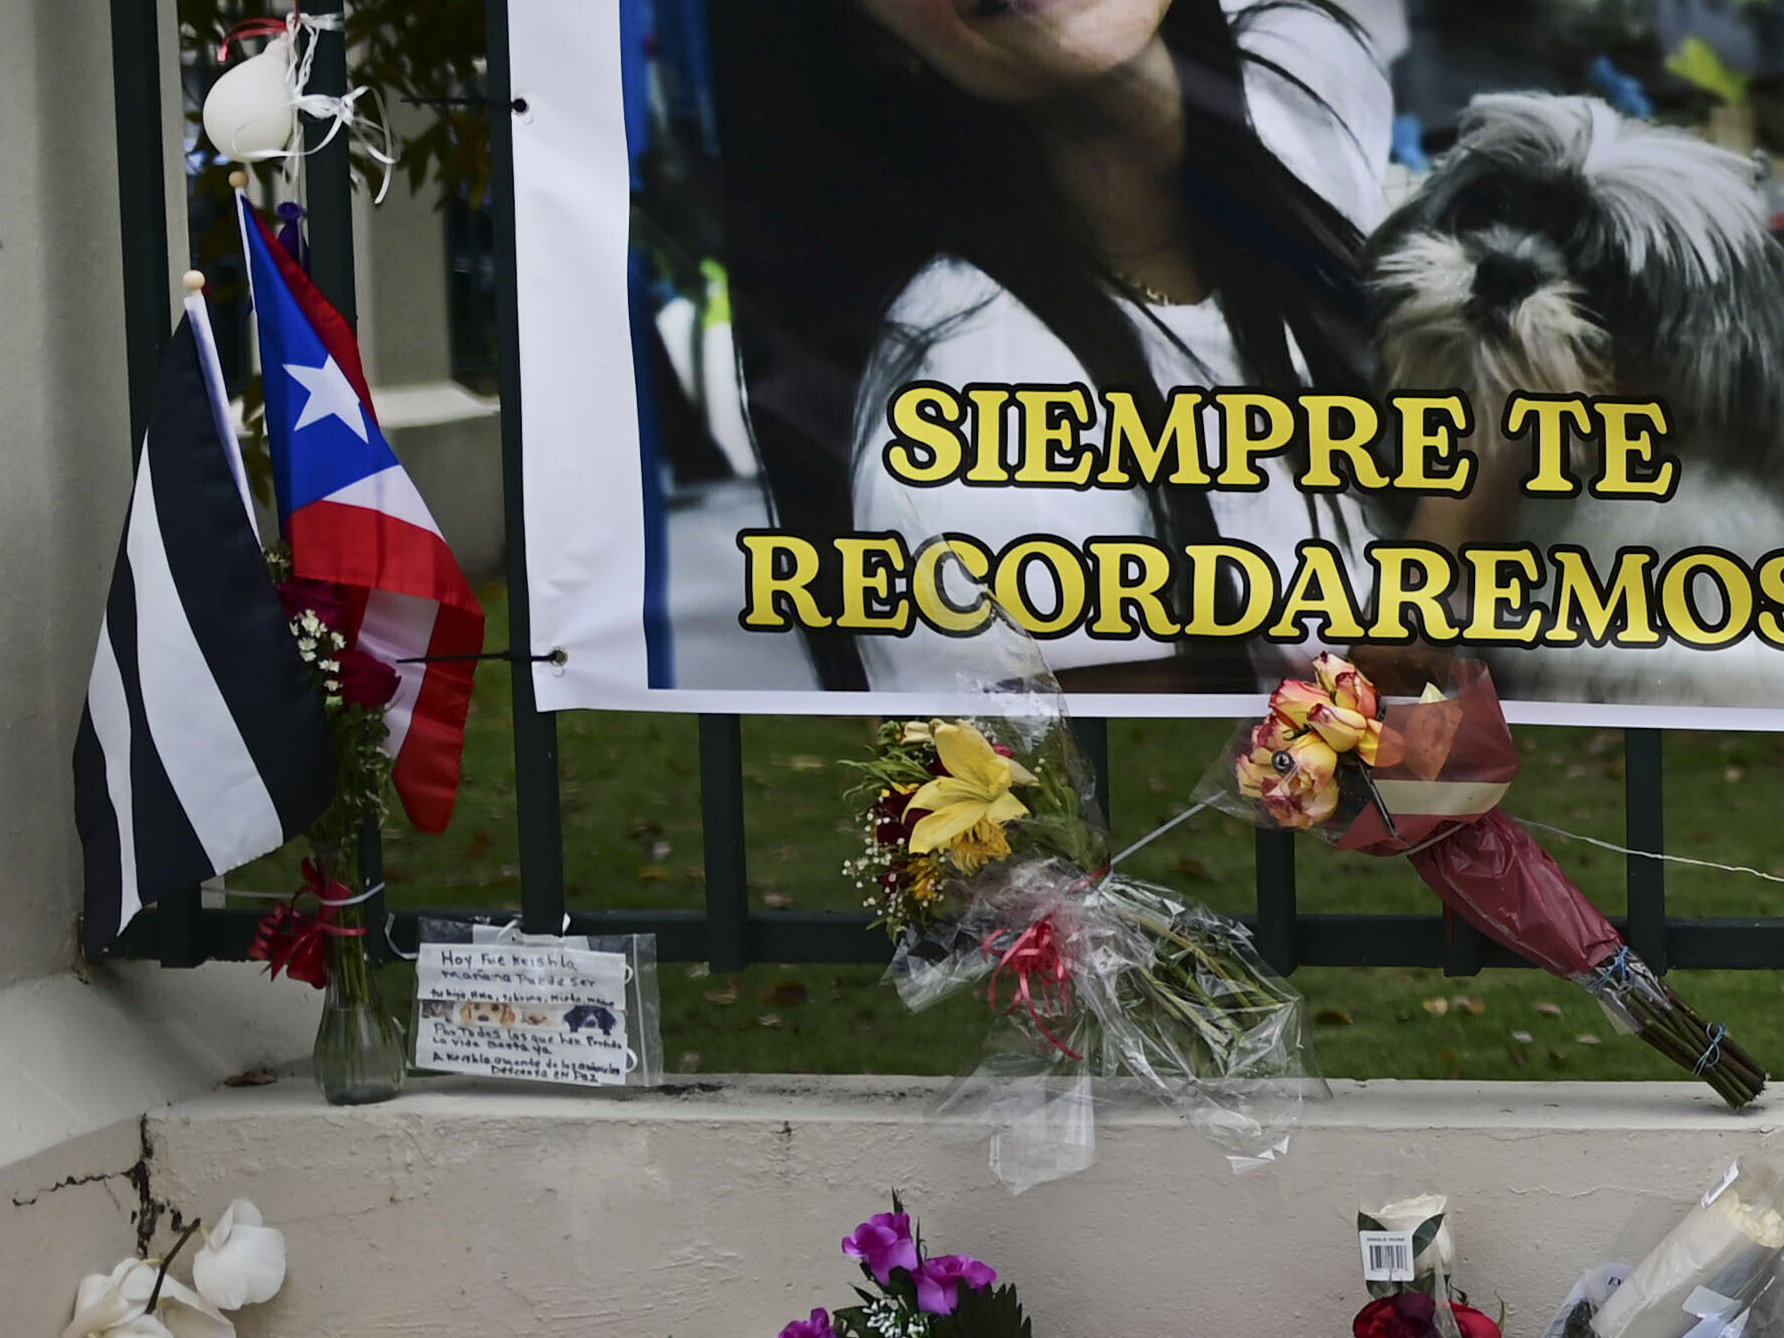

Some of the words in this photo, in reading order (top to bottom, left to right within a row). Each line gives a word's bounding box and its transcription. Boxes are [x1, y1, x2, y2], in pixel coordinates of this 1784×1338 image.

[886, 380, 1474, 494] SIEMPRE
[1503, 390, 1682, 502] TE
[441, 950, 472, 970] Hoy
[481, 953, 506, 967] Fue
[512, 953, 578, 971] Keishla
